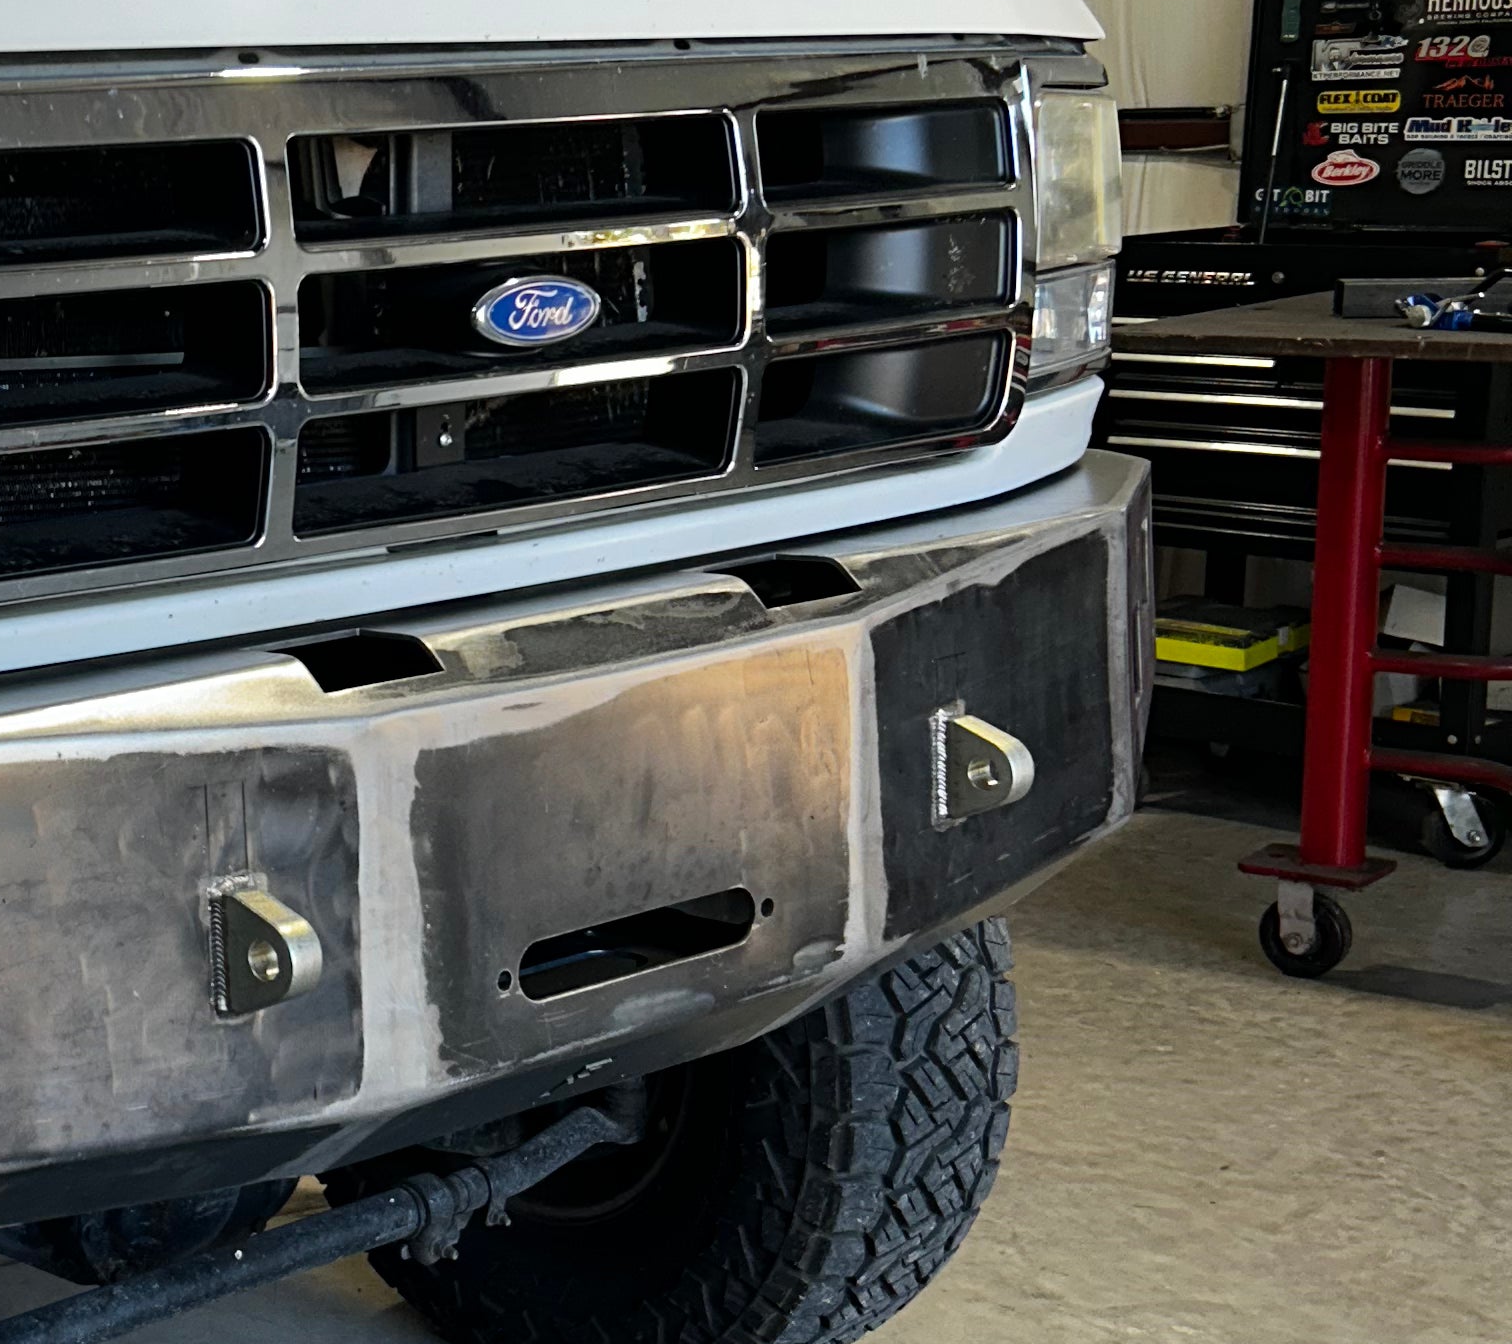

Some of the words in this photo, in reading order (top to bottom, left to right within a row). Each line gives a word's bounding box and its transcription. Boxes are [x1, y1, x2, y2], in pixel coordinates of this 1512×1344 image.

[1320, 94, 1351, 104] FLEX
[1362, 93, 1399, 104] COAT
[1422, 94, 1505, 108] TRAEGER
[1330, 122, 1359, 134] BIG
[1361, 122, 1400, 134] BITE
[1408, 119, 1453, 133] Mud
[1338, 133, 1390, 145] BAITS
[1321, 164, 1371, 179] Berkley
[1400, 170, 1442, 181] MORE
[1255, 188, 1281, 202] GT
[1304, 189, 1330, 203] BIT
[508, 288, 573, 331] Ford
